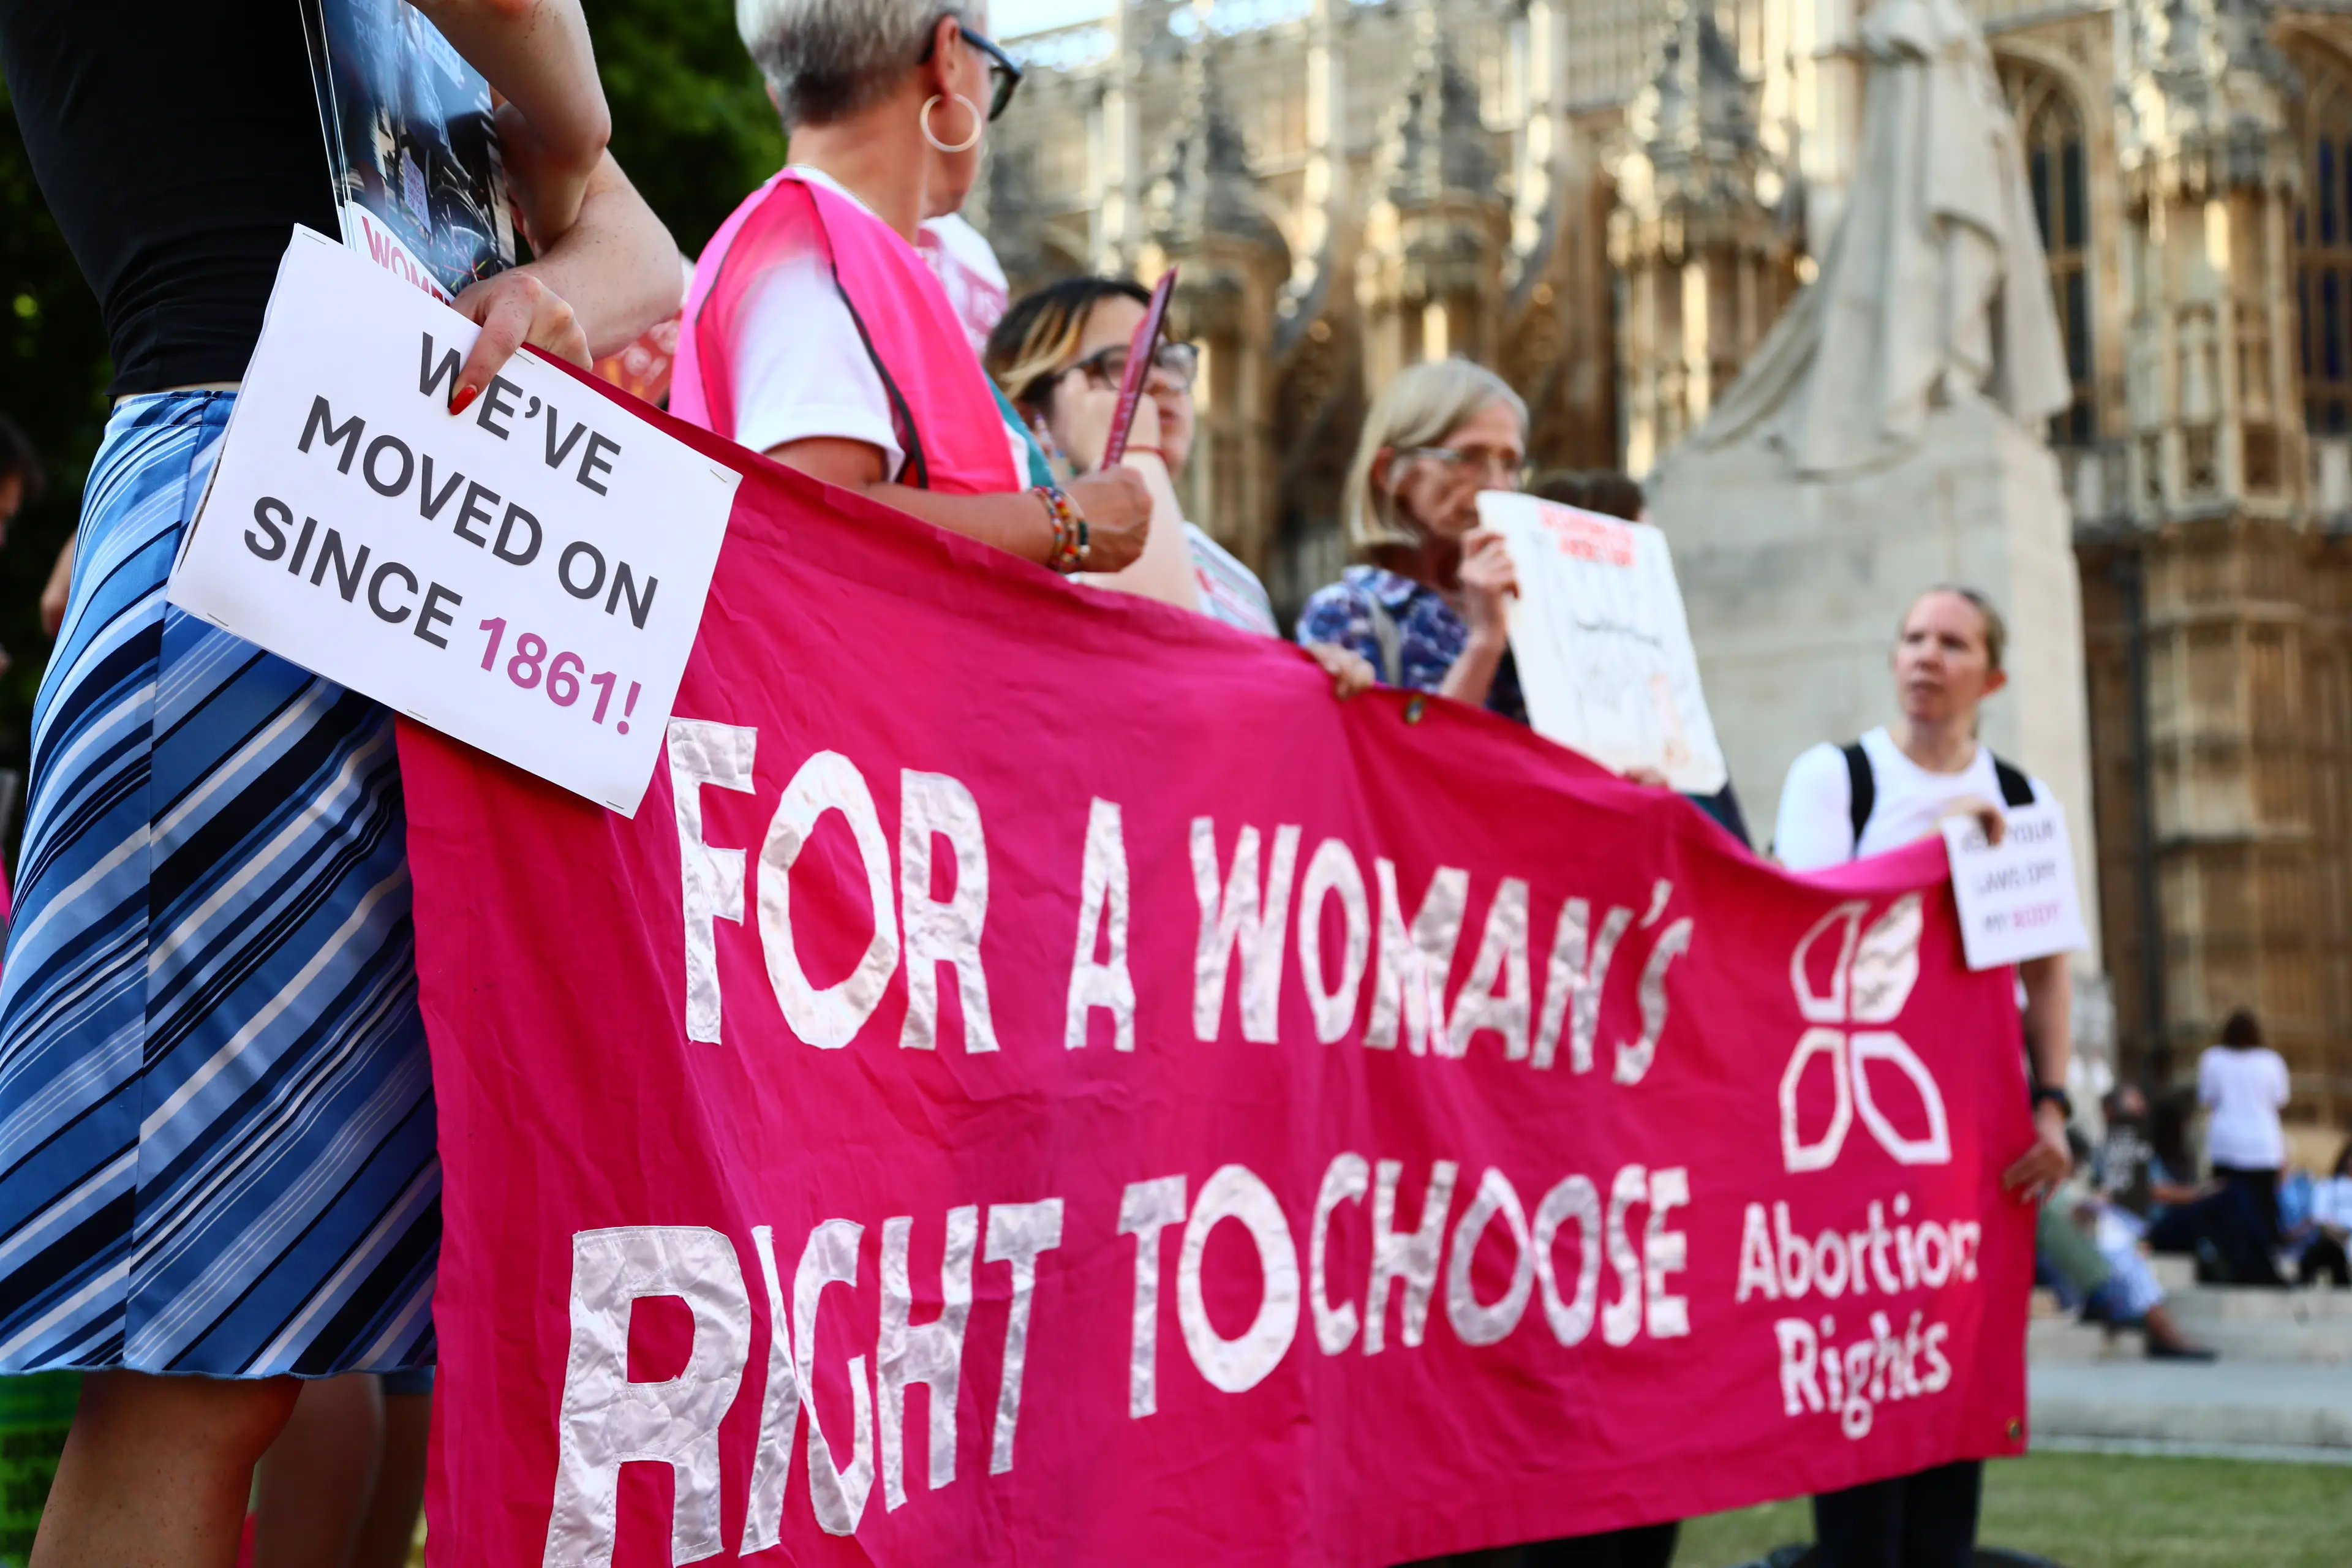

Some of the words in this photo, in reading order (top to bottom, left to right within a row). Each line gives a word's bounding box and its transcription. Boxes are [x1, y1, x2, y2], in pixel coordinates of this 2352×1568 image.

[297, 395, 543, 565] MOVED
[558, 541, 658, 630] ON
[419, 331, 621, 496] WE'VE
[244, 496, 462, 649] SINCE
[478, 617, 641, 734] 1861!
[666, 716, 1001, 1054] FOR
[1064, 795, 1136, 1052] A
[1188, 815, 1694, 1087] WOMAN'S
[542, 1197, 1065, 1568] RIGHT
[1117, 1164, 1300, 1420] TO
[1309, 1152, 1691, 1357] CHOOSE
[1735, 1191, 1981, 1305] Abortion
[1774, 1310, 1952, 1441] Rights
